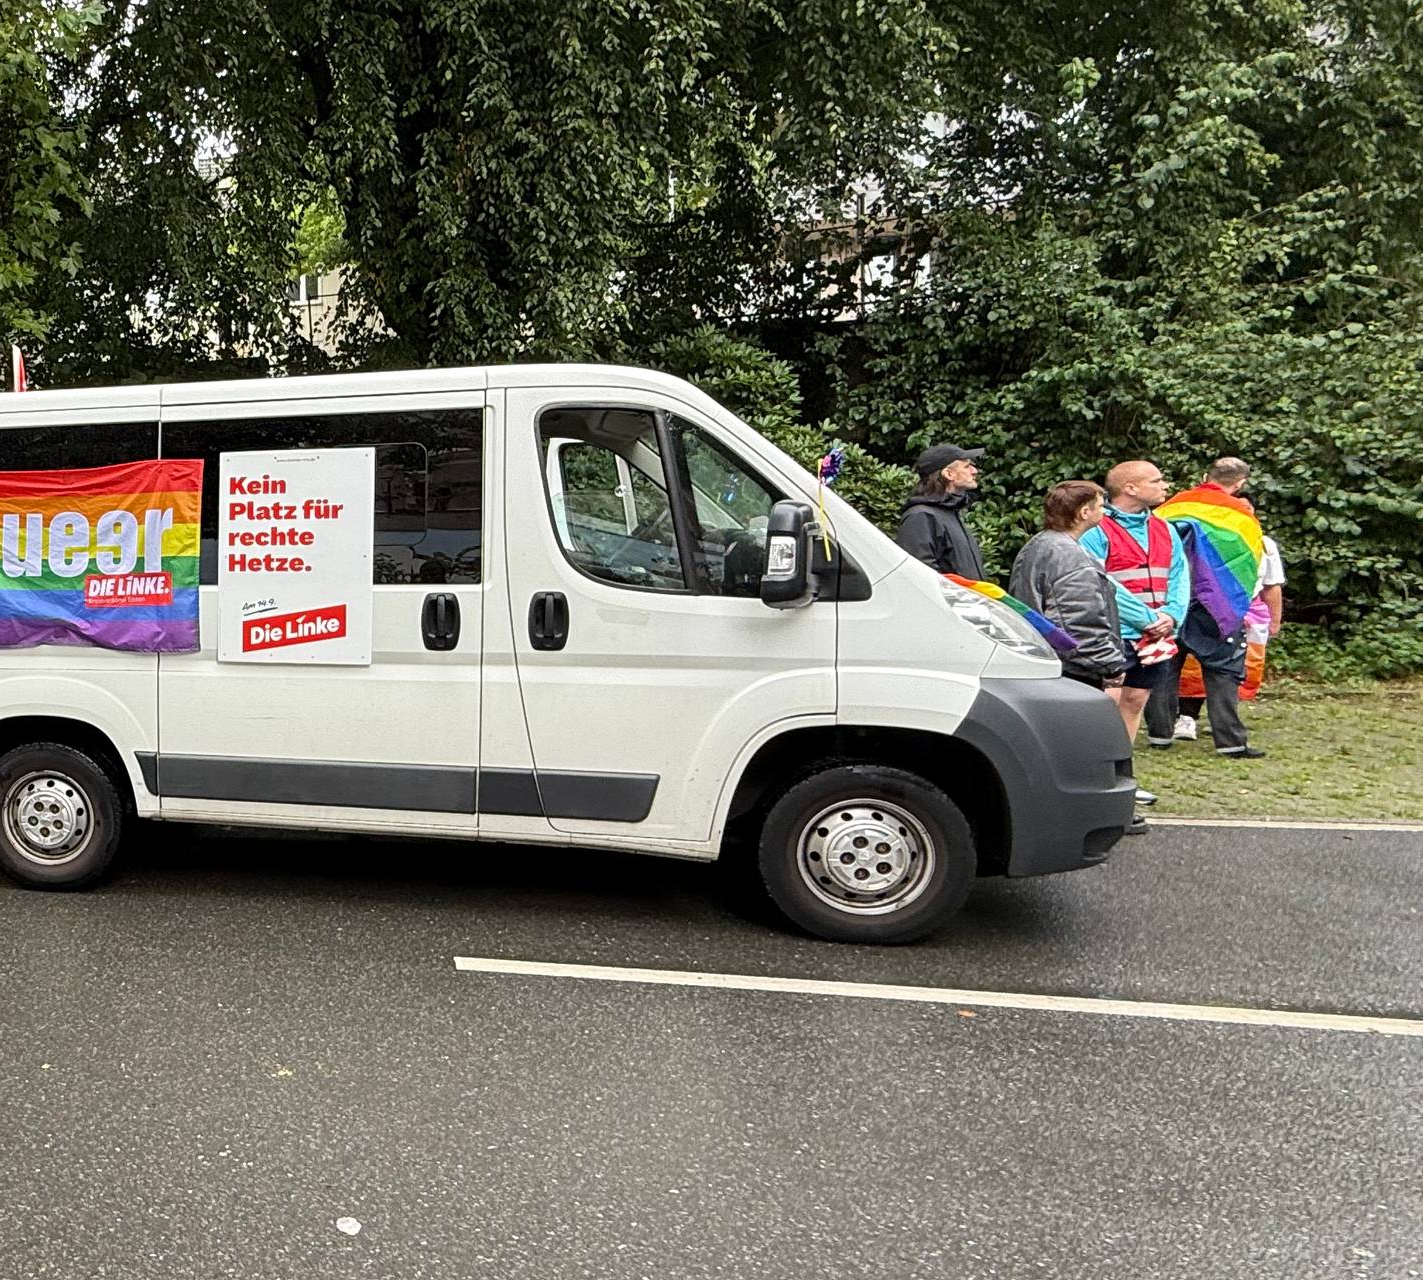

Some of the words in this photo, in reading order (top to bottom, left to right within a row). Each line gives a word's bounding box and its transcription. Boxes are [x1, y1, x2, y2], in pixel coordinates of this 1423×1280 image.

[229, 474, 287, 495] Kein
[229, 501, 297, 521] Platz
[302, 499, 344, 520] für
[228, 526, 315, 547] rechte
[228, 553, 312, 572] Hetze.
[88, 578, 116, 597] DIE
[117, 575, 170, 596] LINKE.
[242, 601, 256, 610] Am
[250, 623, 283, 645] Die
[285, 614, 340, 640] Linke
